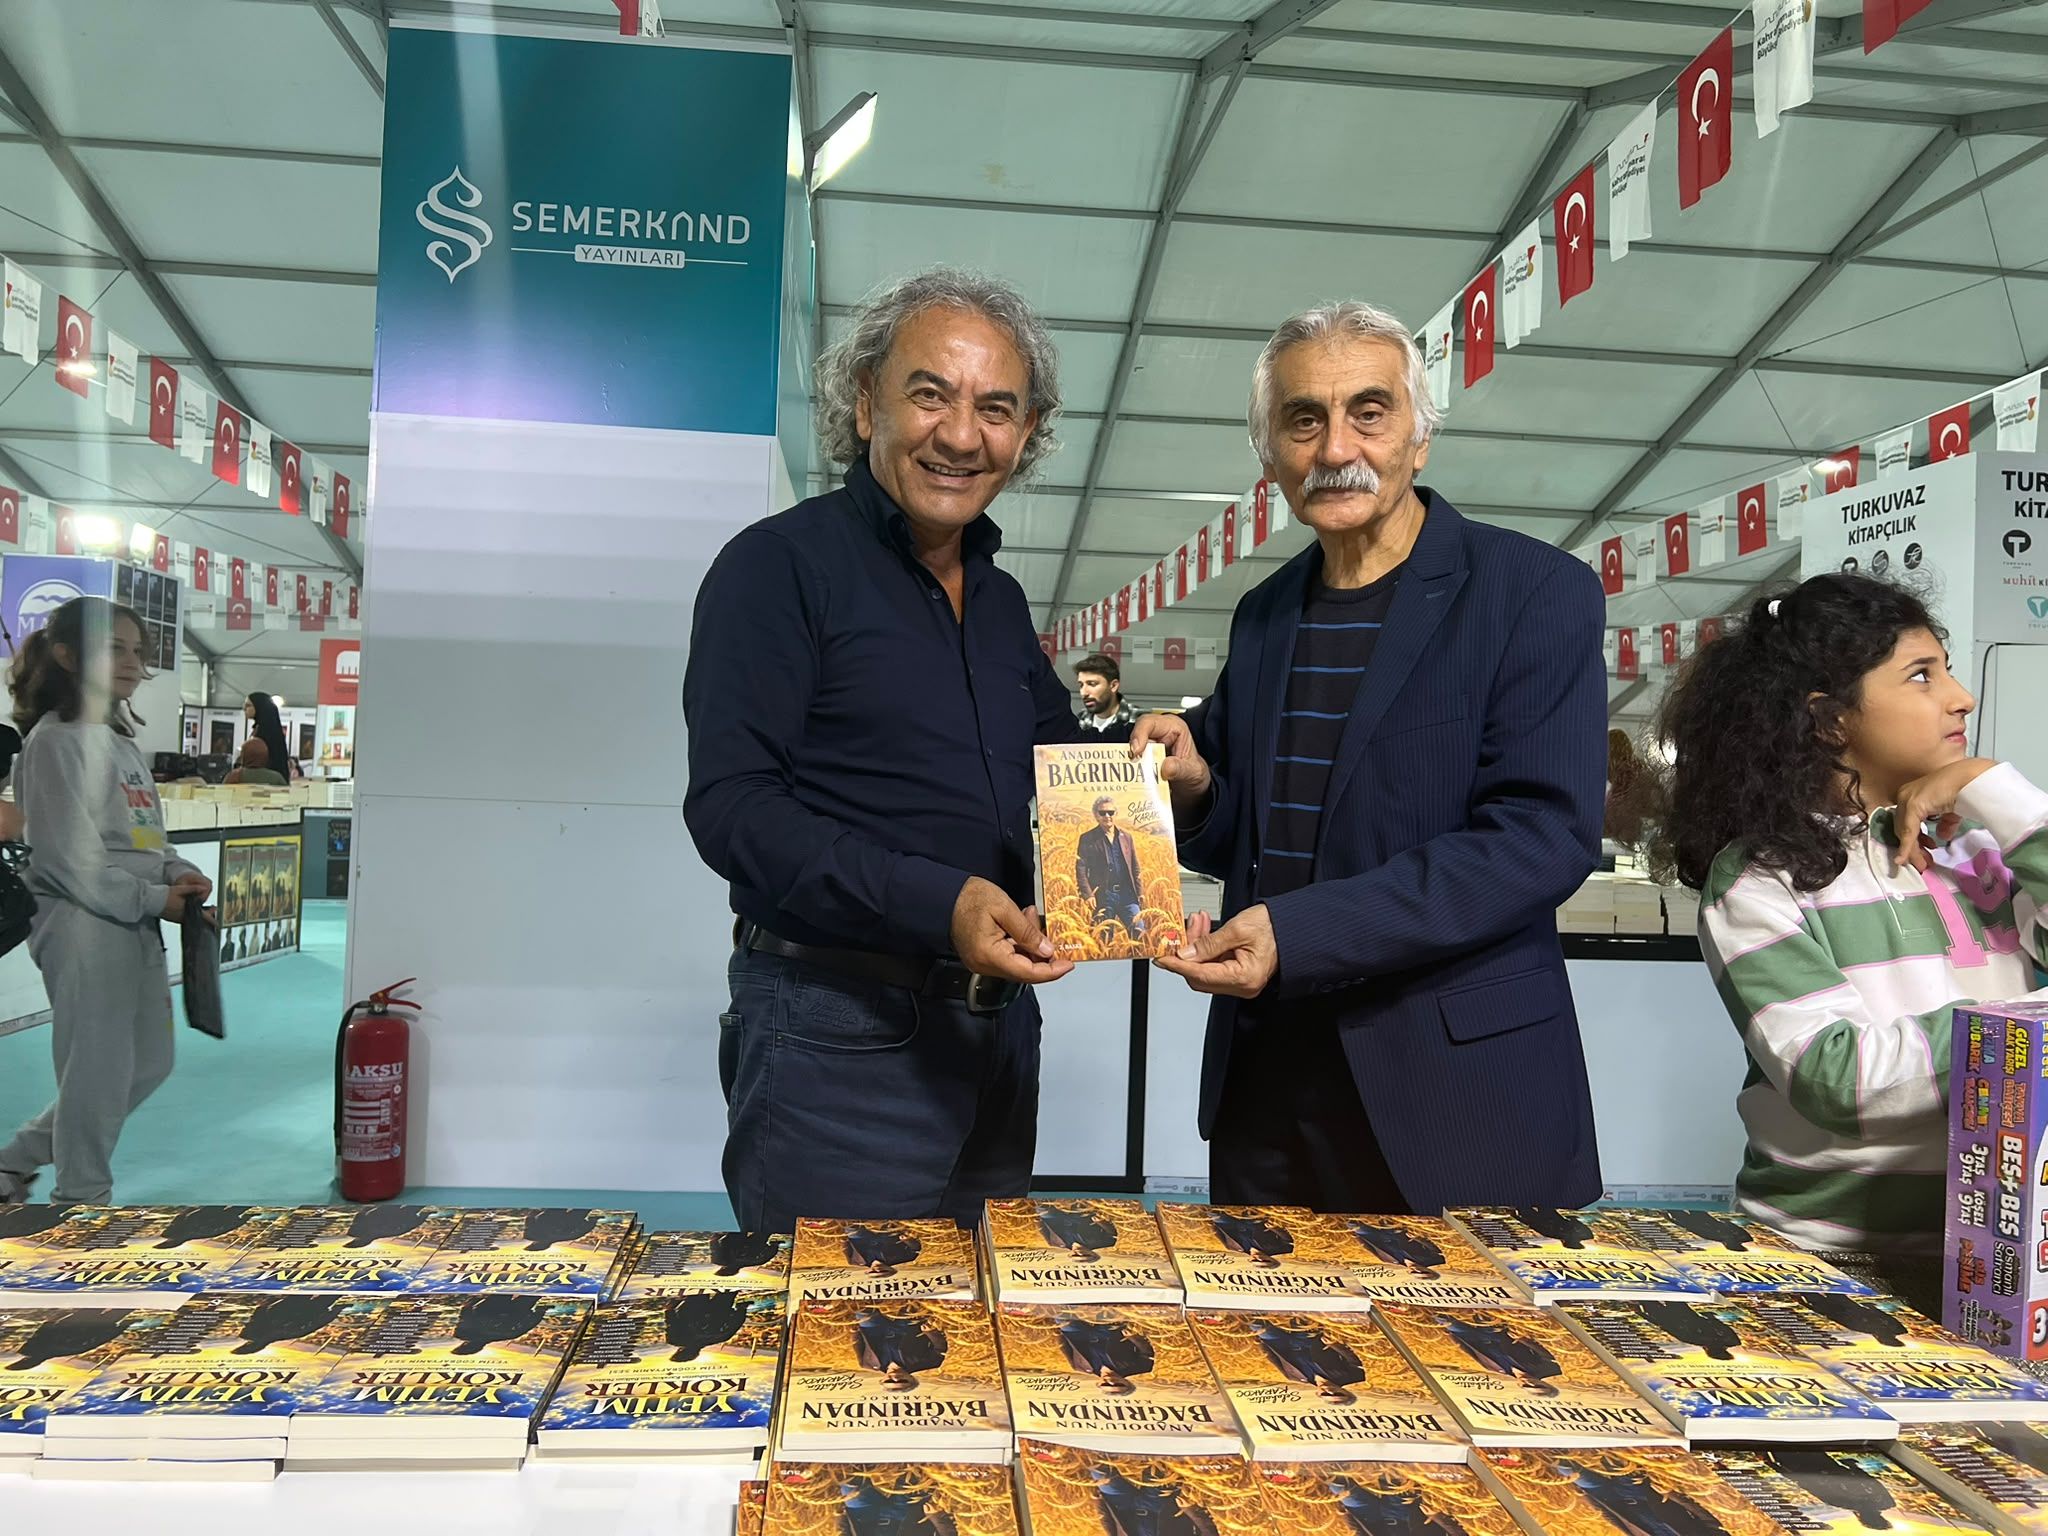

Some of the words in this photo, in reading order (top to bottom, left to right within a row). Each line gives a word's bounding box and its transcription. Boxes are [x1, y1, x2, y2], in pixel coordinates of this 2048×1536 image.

[511, 200, 751, 244] SEMERKAND
[579, 246, 681, 267] YAYINLARI
[1841, 484, 1927, 524] TURKUVAZ
[1847, 514, 1917, 546] KİTAPÇILIK
[1047, 758, 1160, 788] BAĞRINDAN
[1083, 784, 1129, 793] KARAKOÇ
[2004, 1018, 2015, 1047] AHLAK
[1966, 1015, 1984, 1072] MÜBAREK
[2014, 1027, 2030, 1070] GÜZEL
[2002, 1047, 2015, 1075] YARIŞI
[350, 1062, 403, 1078] AKSU
[1972, 1189, 1987, 1228] KÖŞELİ
[54, 1260, 208, 1273] KÖKLER
[256, 1259, 404, 1272] KÖKLER
[446, 1261, 589, 1275] KÖKLER
[1523, 1260, 1656, 1272] KÖKLER
[1691, 1261, 1823, 1273] KÖKLER
[1991, 1241, 2006, 1296] Satrancı
[2003, 1246, 2018, 1297] Osmanlı
[51, 1269, 180, 1283] YETİM
[254, 1269, 382, 1283] YETİM
[447, 1271, 573, 1286] YETİM
[1010, 1268, 1162, 1282] BAĞRINDAN
[1193, 1269, 1347, 1289] BAĞRINDAN
[1548, 1268, 1668, 1283] YETİM
[1718, 1271, 1840, 1286] YETİM
[801, 1273, 953, 1299] BAĞRINDAN
[1032, 1280, 1147, 1288] ANADOLU'NUN
[1217, 1285, 1331, 1295] ANADOLU'NUN
[1361, 1284, 1512, 1300] BAĞRINDAN
[1388, 1296, 1500, 1306] ANADOLU'NUN
[2032, 1306, 2047, 1344] 3
[1841, 1361, 2001, 1374] KÖKLER
[119, 1371, 299, 1387] KÖKLER
[351, 1371, 524, 1387] KÖKLER
[806, 1378, 864, 1392] Selahattin
[1025, 1380, 1081, 1392] Selahattin
[1664, 1375, 1830, 1391] KÖKLER
[1879, 1373, 2023, 1391] YETİM
[106, 1385, 266, 1405] YETİM
[347, 1385, 501, 1405] YETİM
[584, 1377, 749, 1398] KÖKLER
[1247, 1389, 1302, 1403] Selahattin
[1512, 1397, 1584, 1407] KARAKOÇ
[1695, 1389, 1849, 1409] YETİM
[588, 1394, 737, 1418] YETİM
[800, 1400, 989, 1421] BAĞRINDAN
[1028, 1400, 1214, 1424] BAĞRINDAN
[1465, 1397, 1653, 1426] BAĞRINDAN
[826, 1418, 967, 1429] ANADOLU'NUN
[1055, 1420, 1194, 1433] ANADOLU'NUN
[1255, 1414, 1444, 1433] BAĞRINDAN
[1503, 1418, 1639, 1436] ANADOLU'NUN
[1290, 1430, 1429, 1441] ANADOLU'NUN
